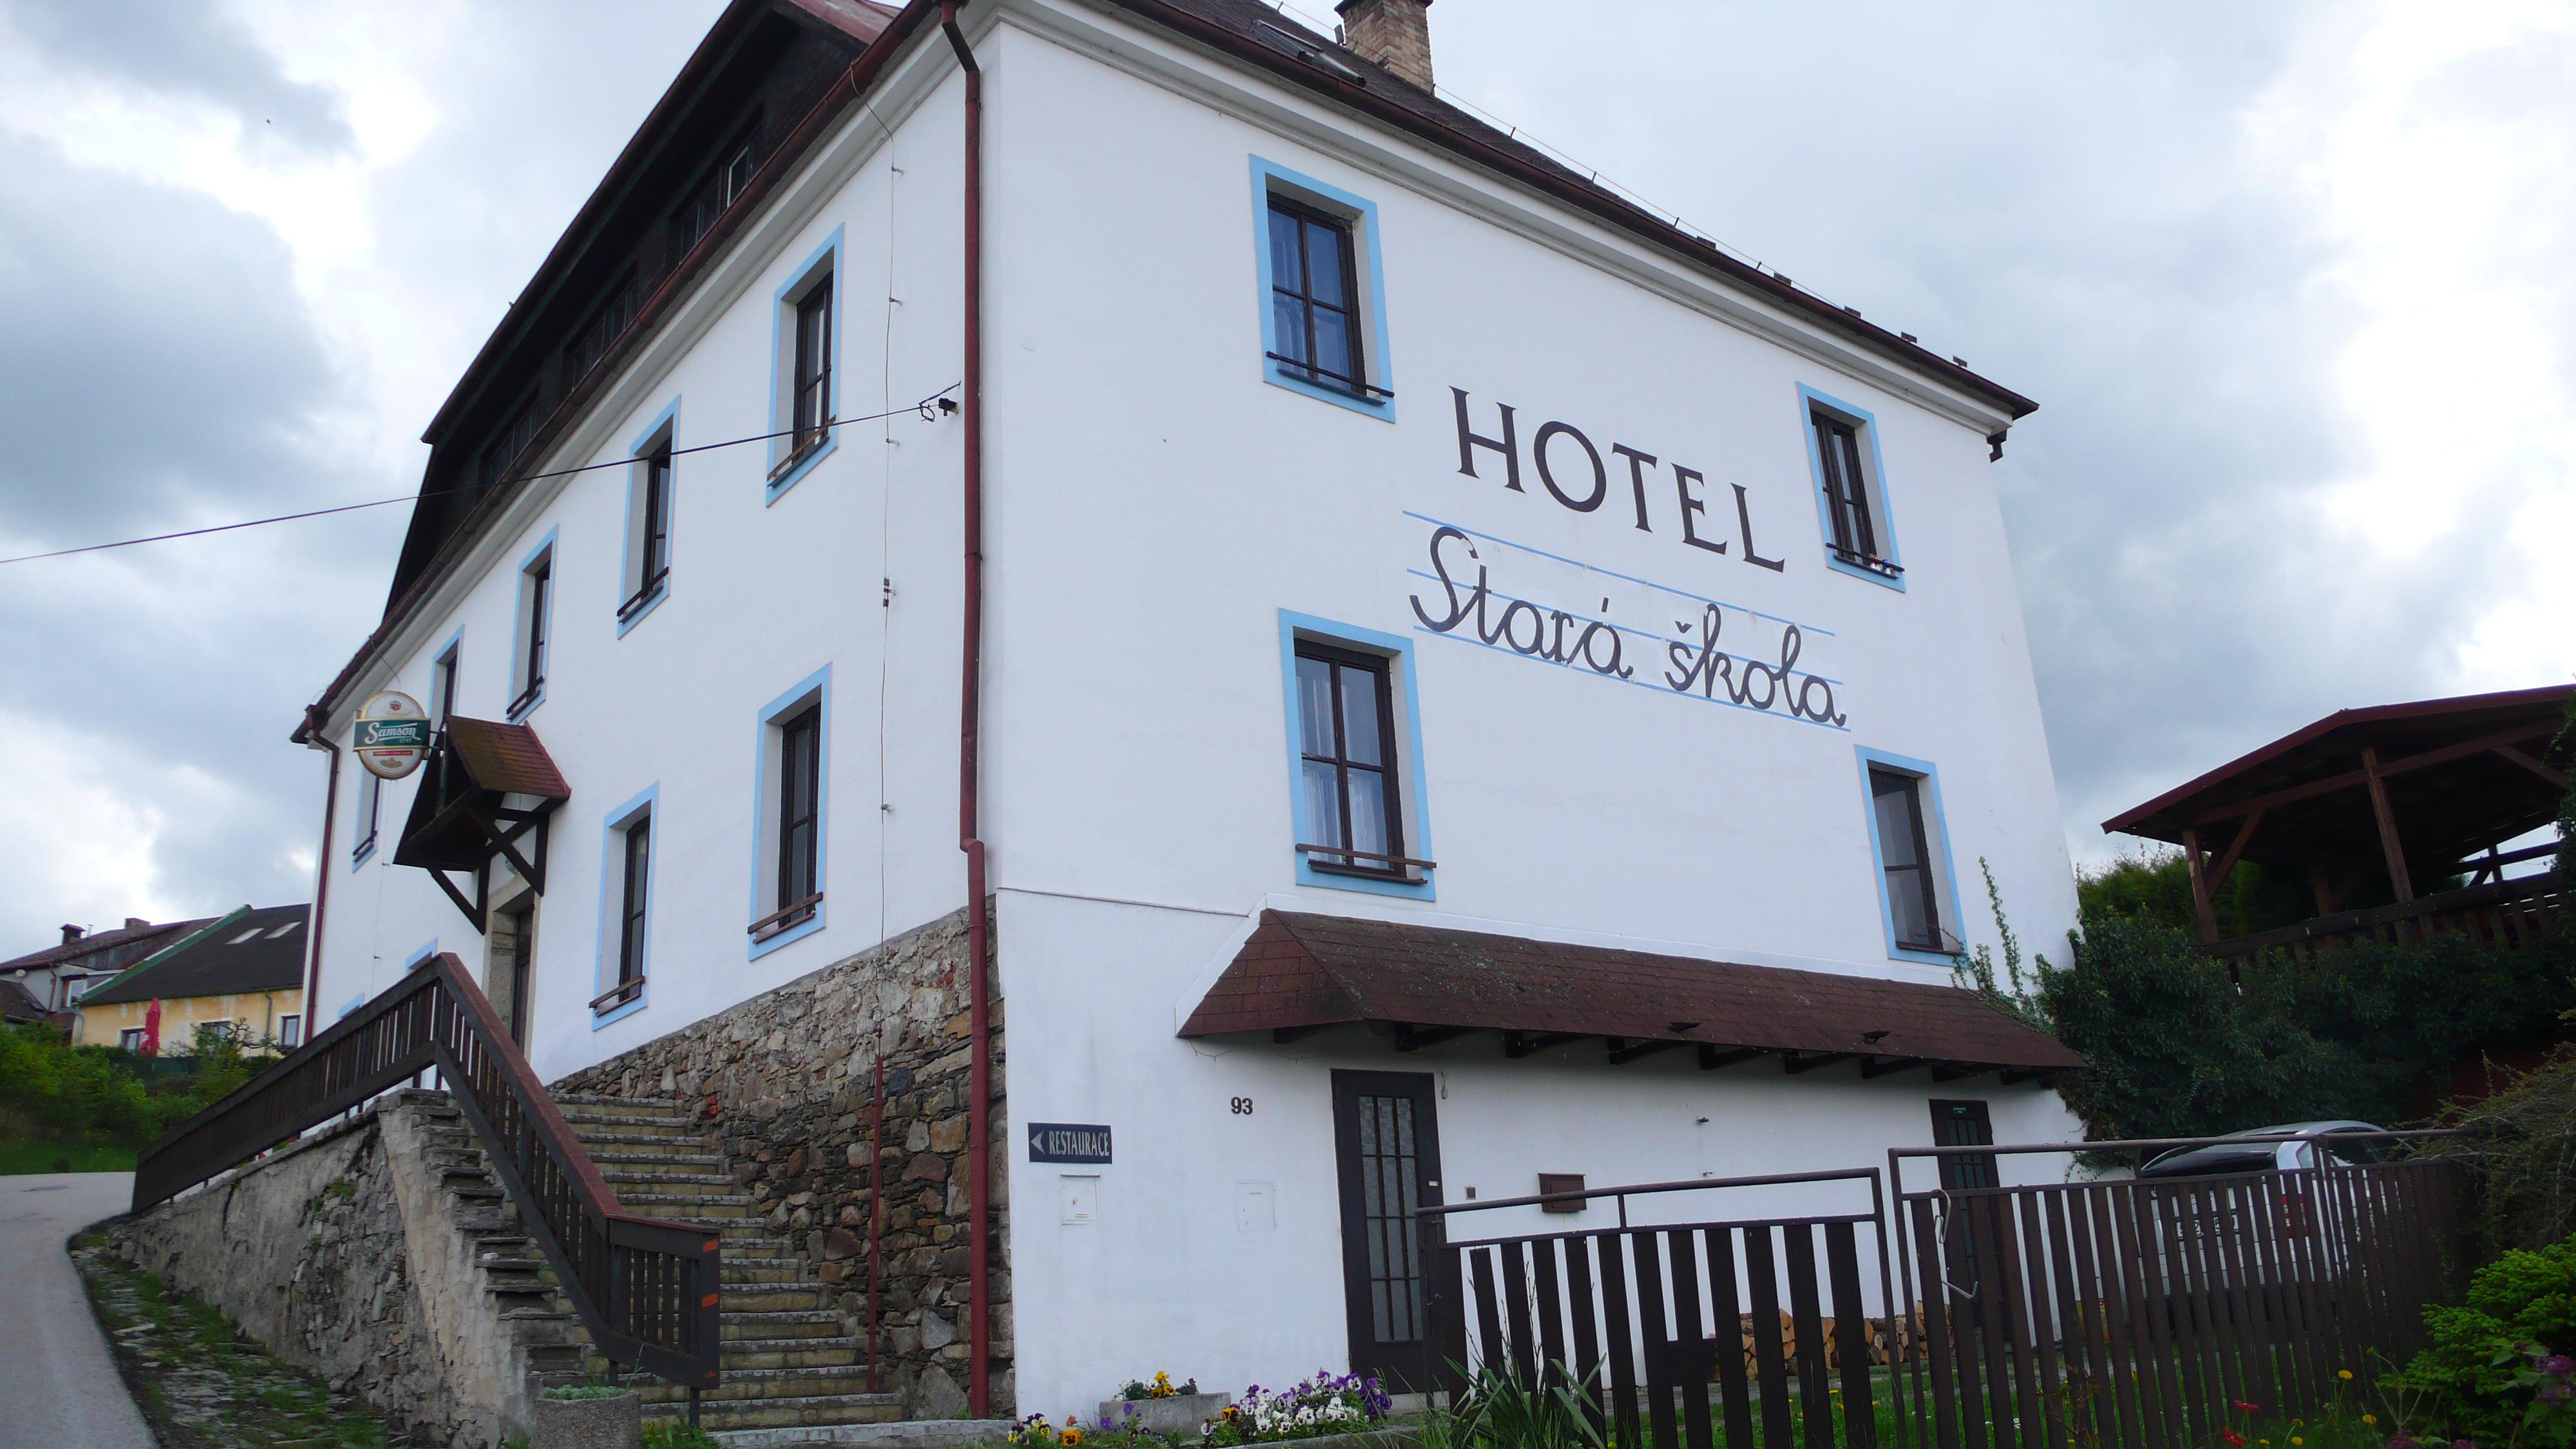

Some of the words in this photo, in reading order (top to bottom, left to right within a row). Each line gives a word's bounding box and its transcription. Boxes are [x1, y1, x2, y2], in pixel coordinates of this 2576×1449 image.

[1448, 384, 1785, 573] HOTEL
[1408, 526, 1633, 679] Stará
[1664, 603, 1846, 727] škola
[365, 722, 422, 744] Samson
[1231, 1096, 1253, 1115] 93
[1048, 1130, 1110, 1157] RESTAURACE
